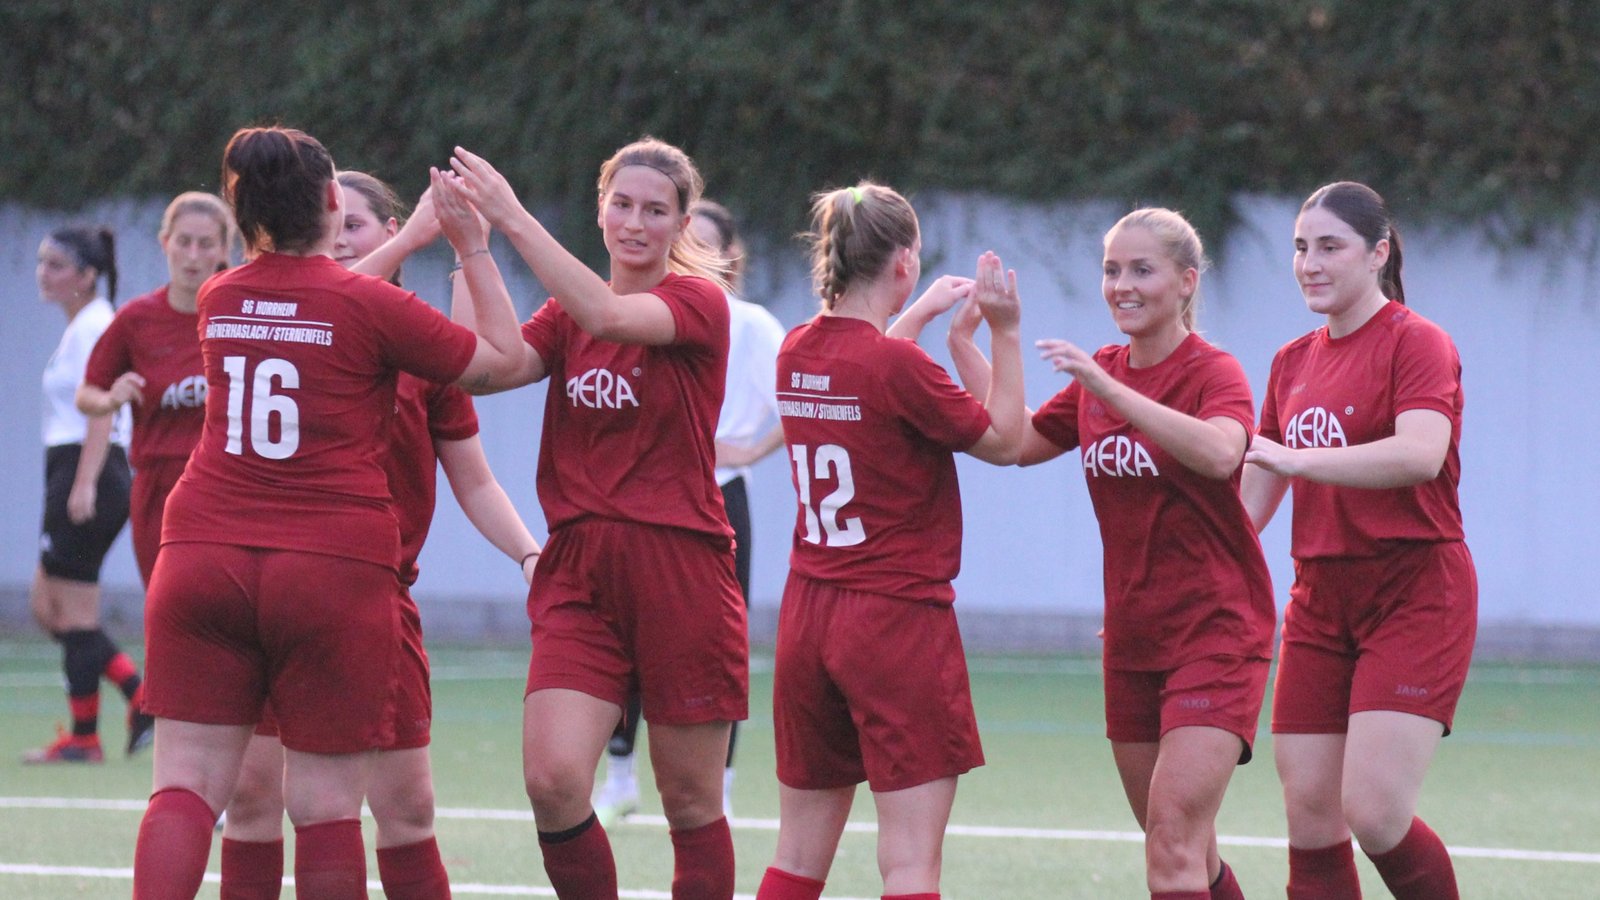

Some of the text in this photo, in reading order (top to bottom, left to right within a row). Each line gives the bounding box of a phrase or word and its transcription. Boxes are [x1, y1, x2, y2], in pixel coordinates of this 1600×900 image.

[242, 300, 297, 317] SG HORRHEIM
[161, 375, 209, 410] AER
[791, 372, 800, 388] SG
[223, 356, 299, 460] 16
[1285, 406, 1348, 449] AERA
[1083, 435, 1159, 477] AERA
[791, 444, 866, 547] 12
